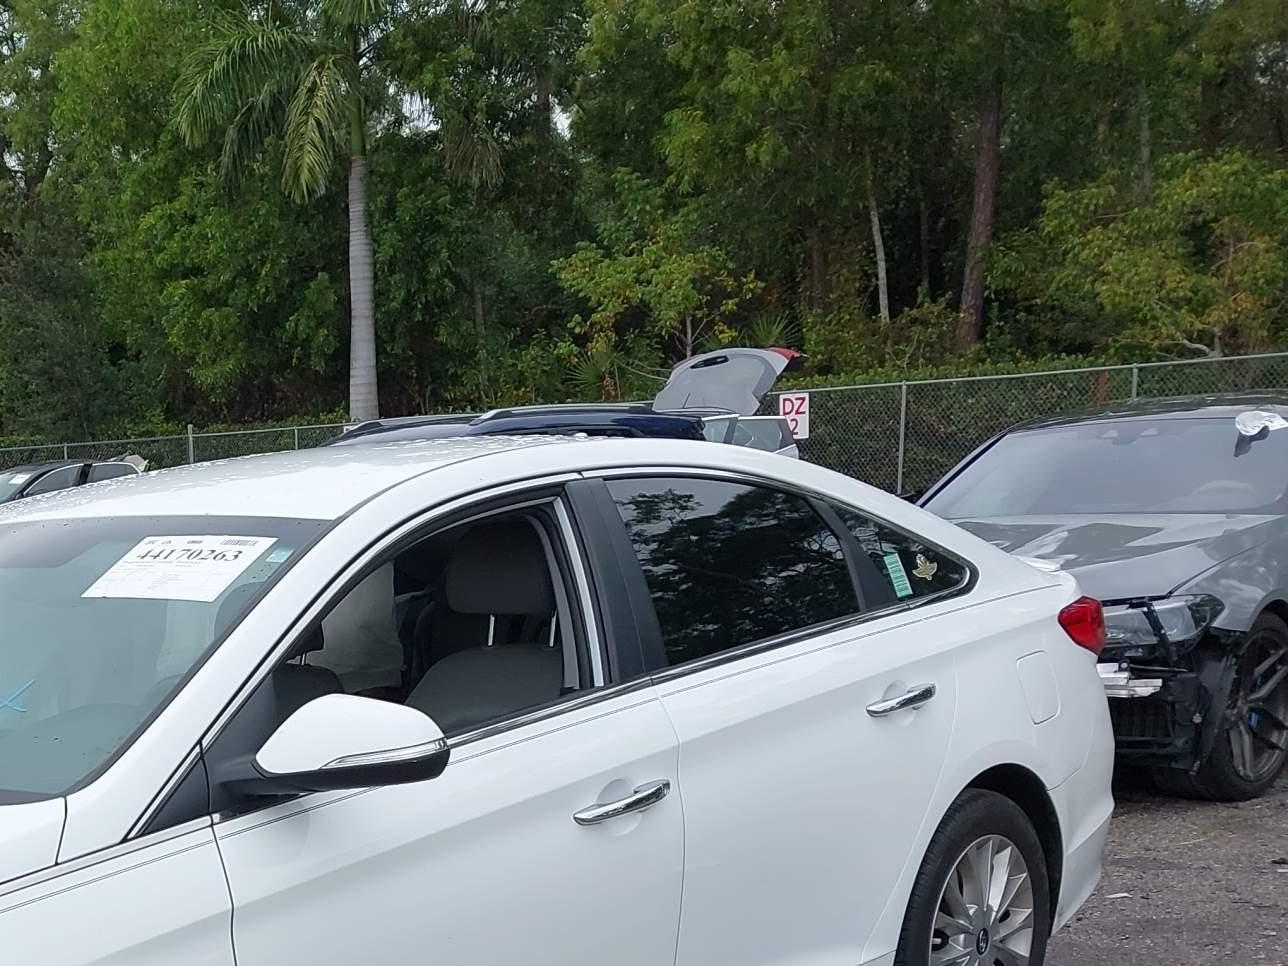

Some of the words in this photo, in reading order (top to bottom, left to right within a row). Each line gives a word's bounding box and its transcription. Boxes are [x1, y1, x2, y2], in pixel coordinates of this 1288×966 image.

[782, 397, 806, 416] DZ
[790, 418, 799, 436] 2
[136, 548, 244, 562] 44170263
